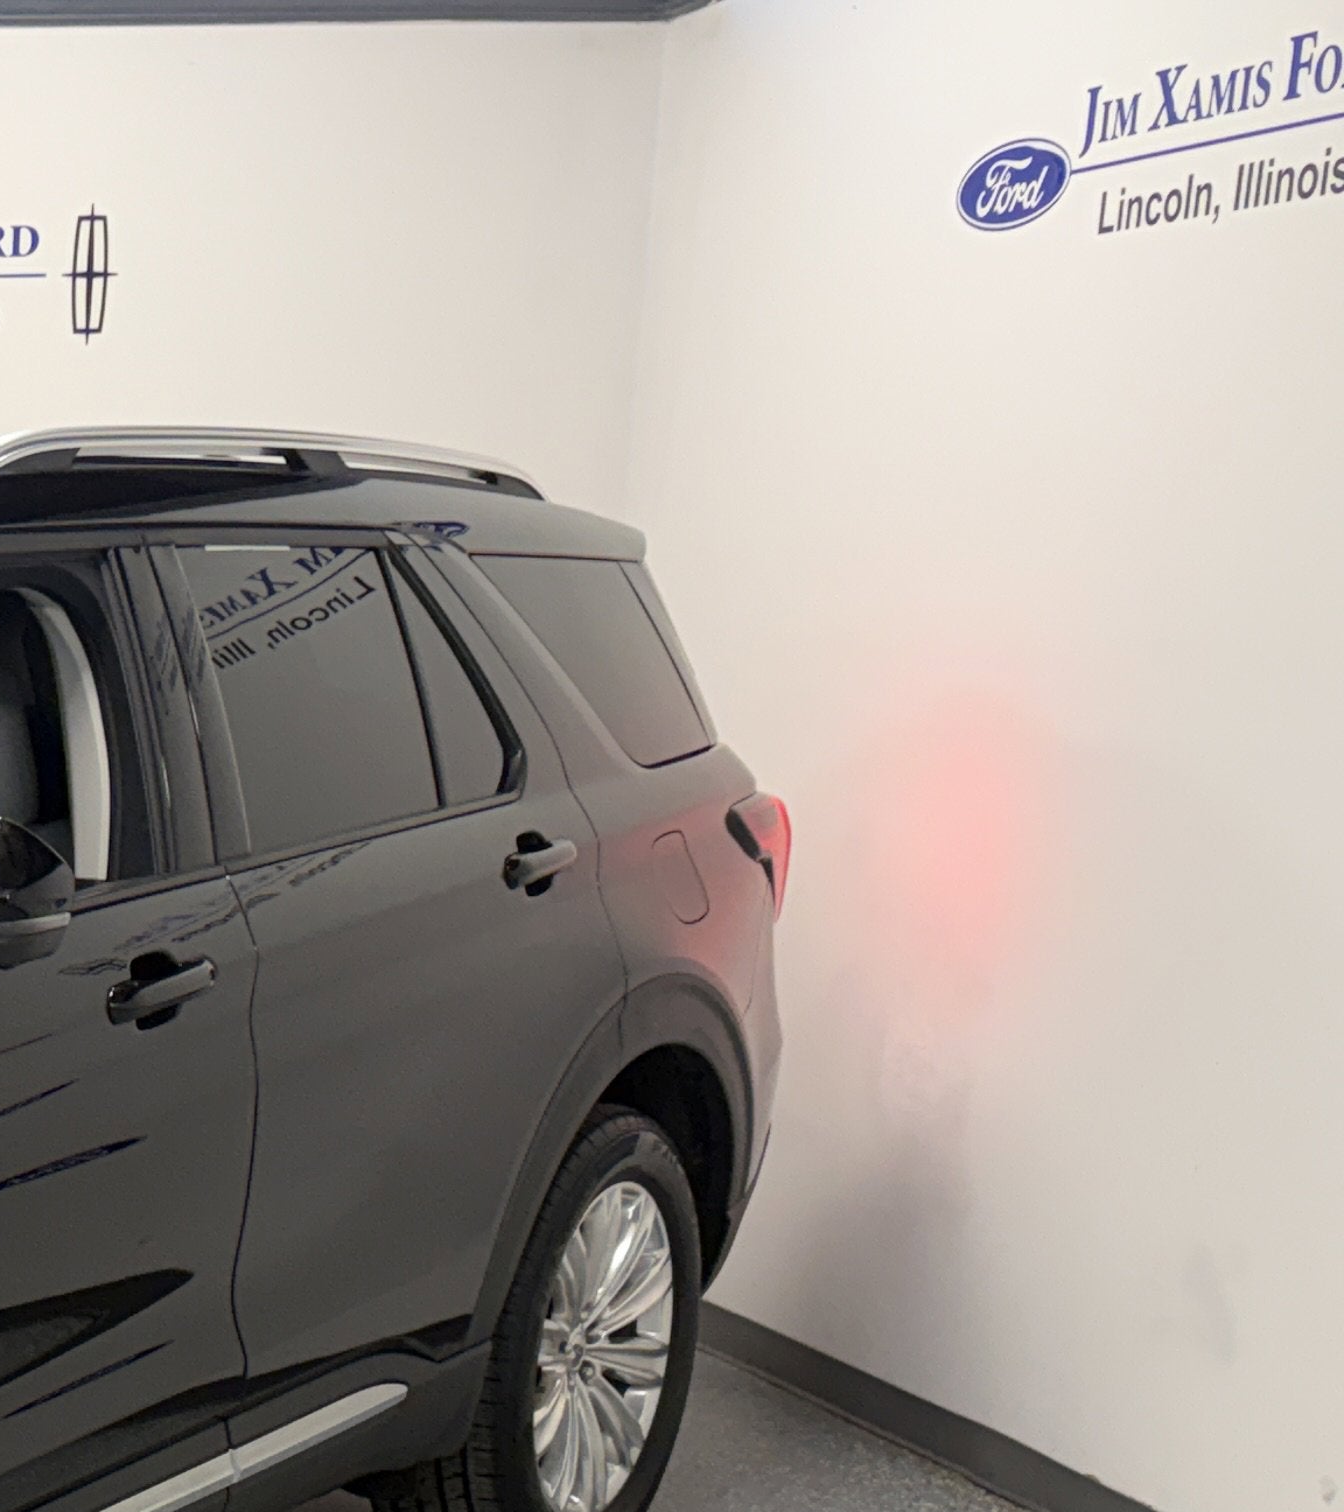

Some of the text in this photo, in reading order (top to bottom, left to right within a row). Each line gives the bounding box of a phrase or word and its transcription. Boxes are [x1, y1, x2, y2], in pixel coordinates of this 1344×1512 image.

[1283, 31, 1344, 101] FO
[976, 156, 1049, 218] Ford
[1097, 173, 1220, 234] Lincoln,
